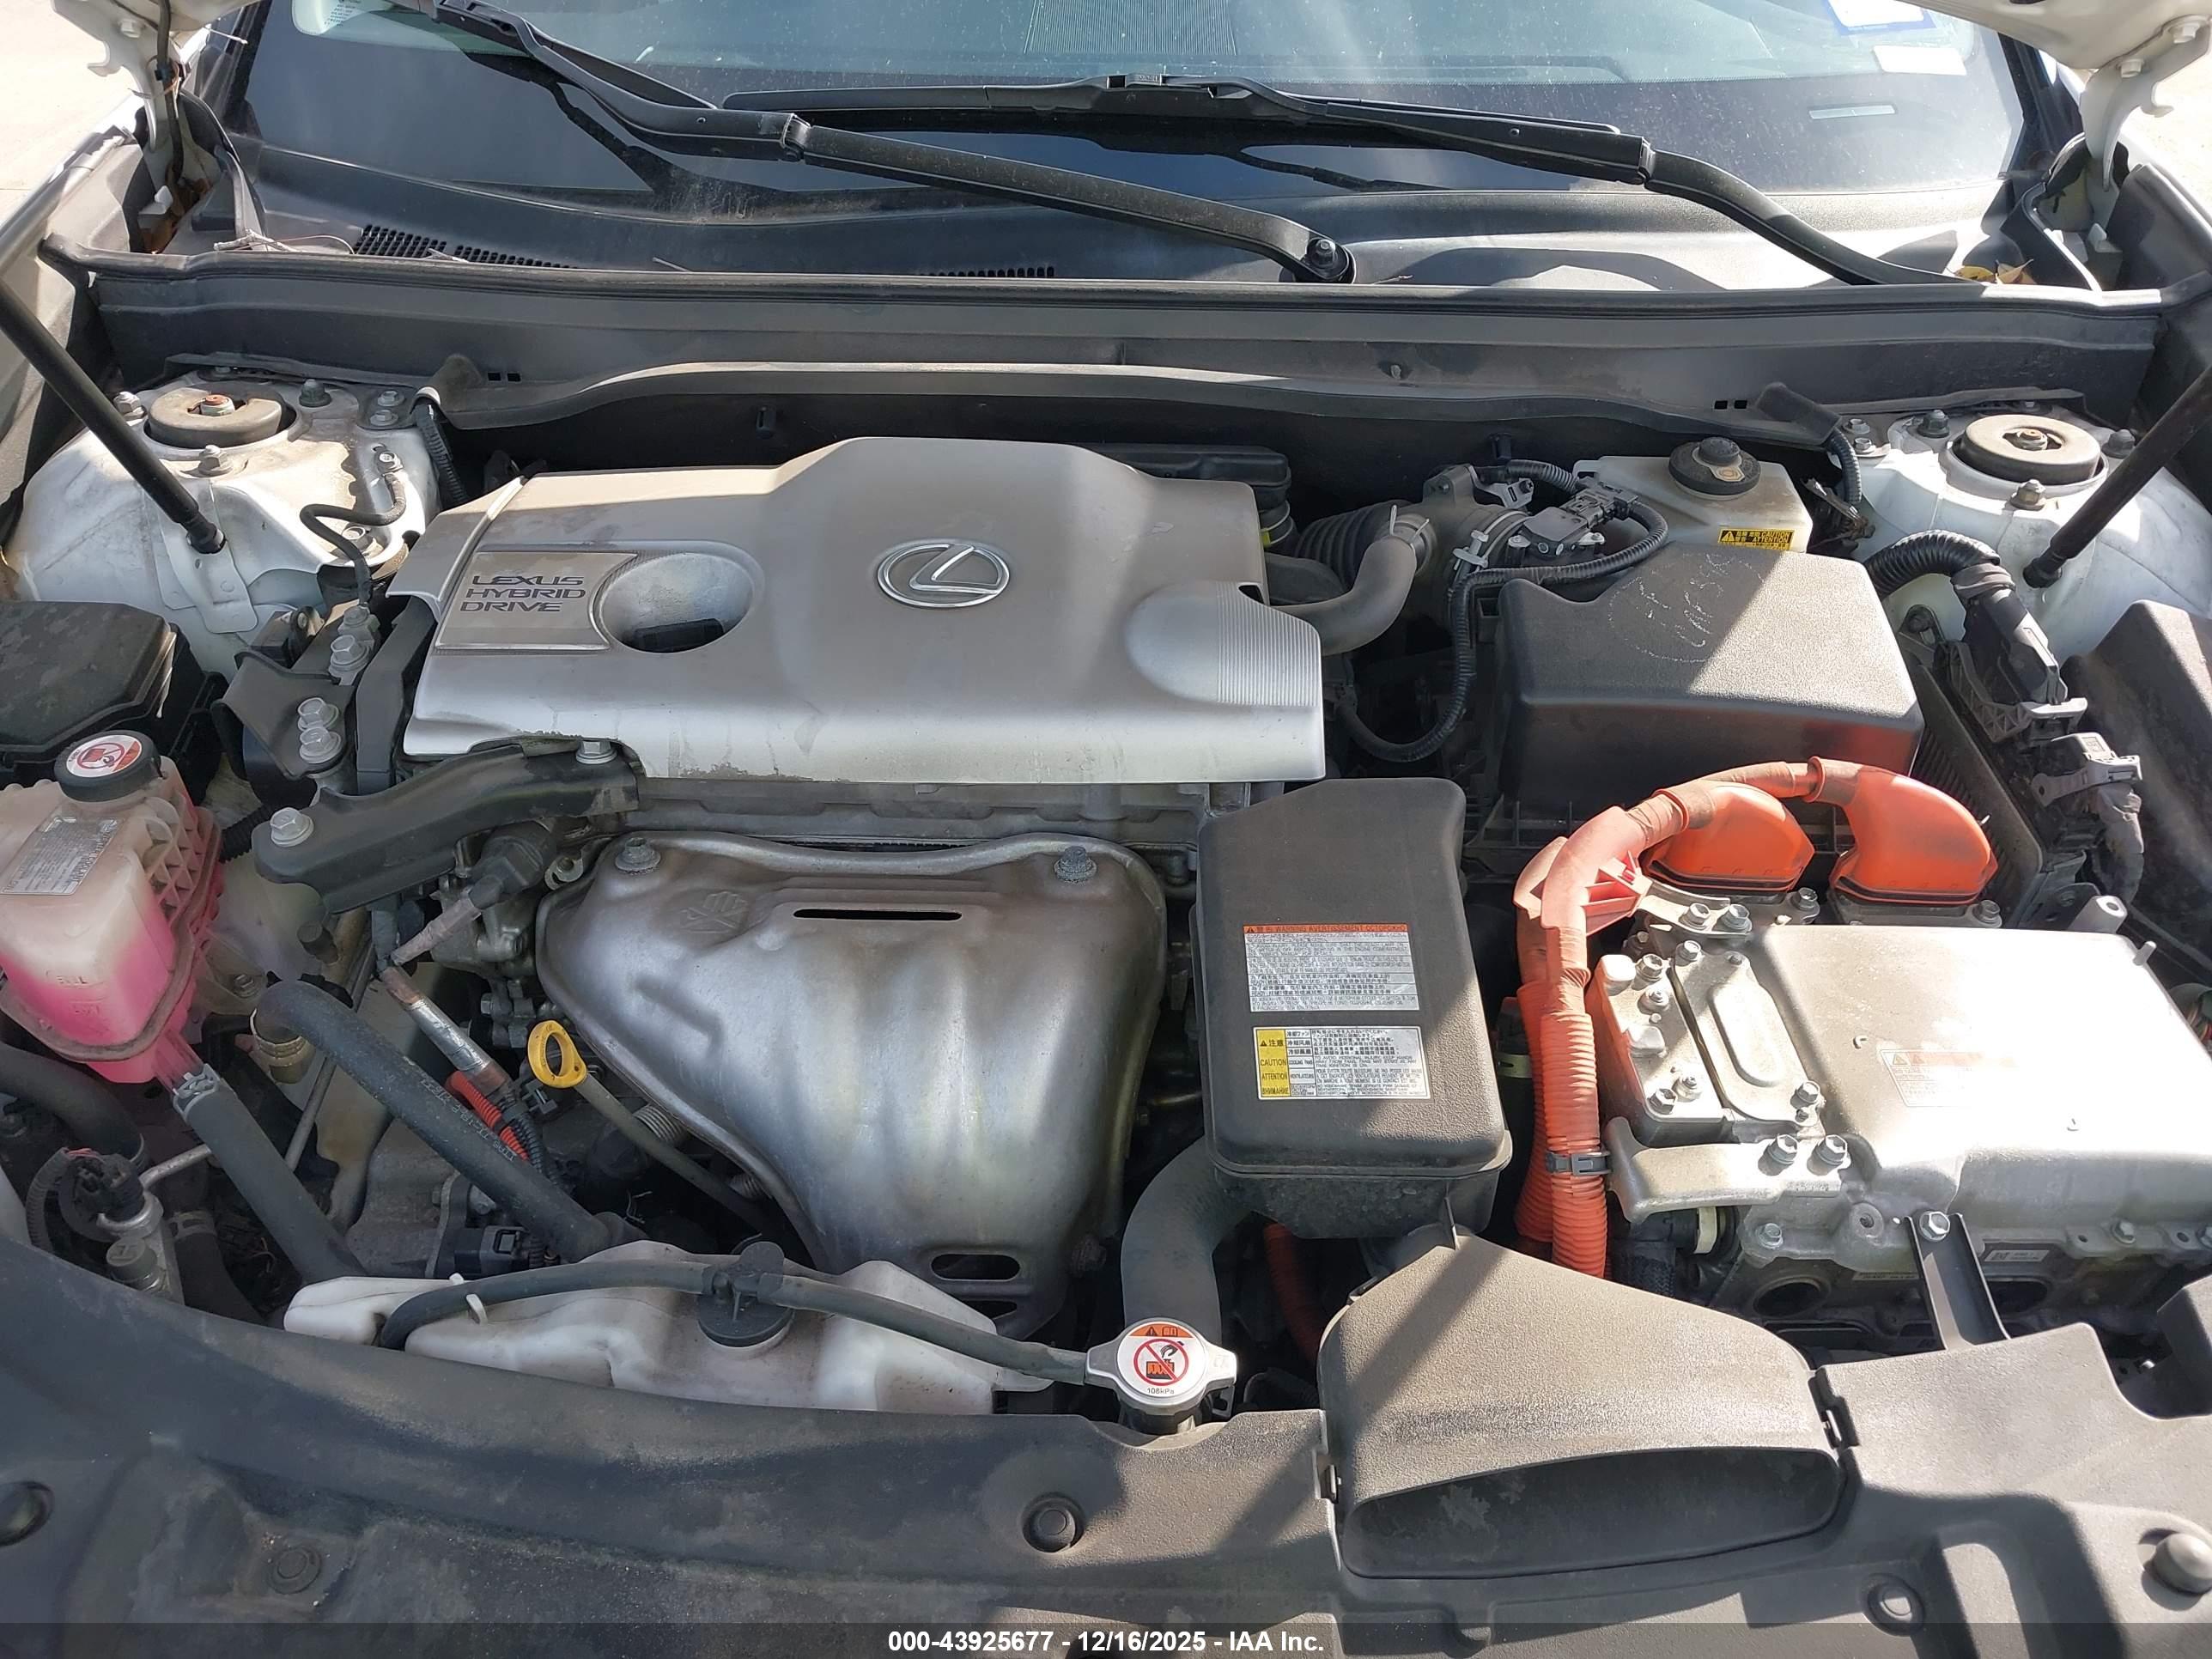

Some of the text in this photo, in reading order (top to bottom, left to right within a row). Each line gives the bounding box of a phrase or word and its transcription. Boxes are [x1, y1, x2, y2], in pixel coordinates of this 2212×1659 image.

[472, 575, 585, 586] LEXUS
[465, 588, 586, 599] HYBRID
[459, 601, 563, 612] DRIVE
